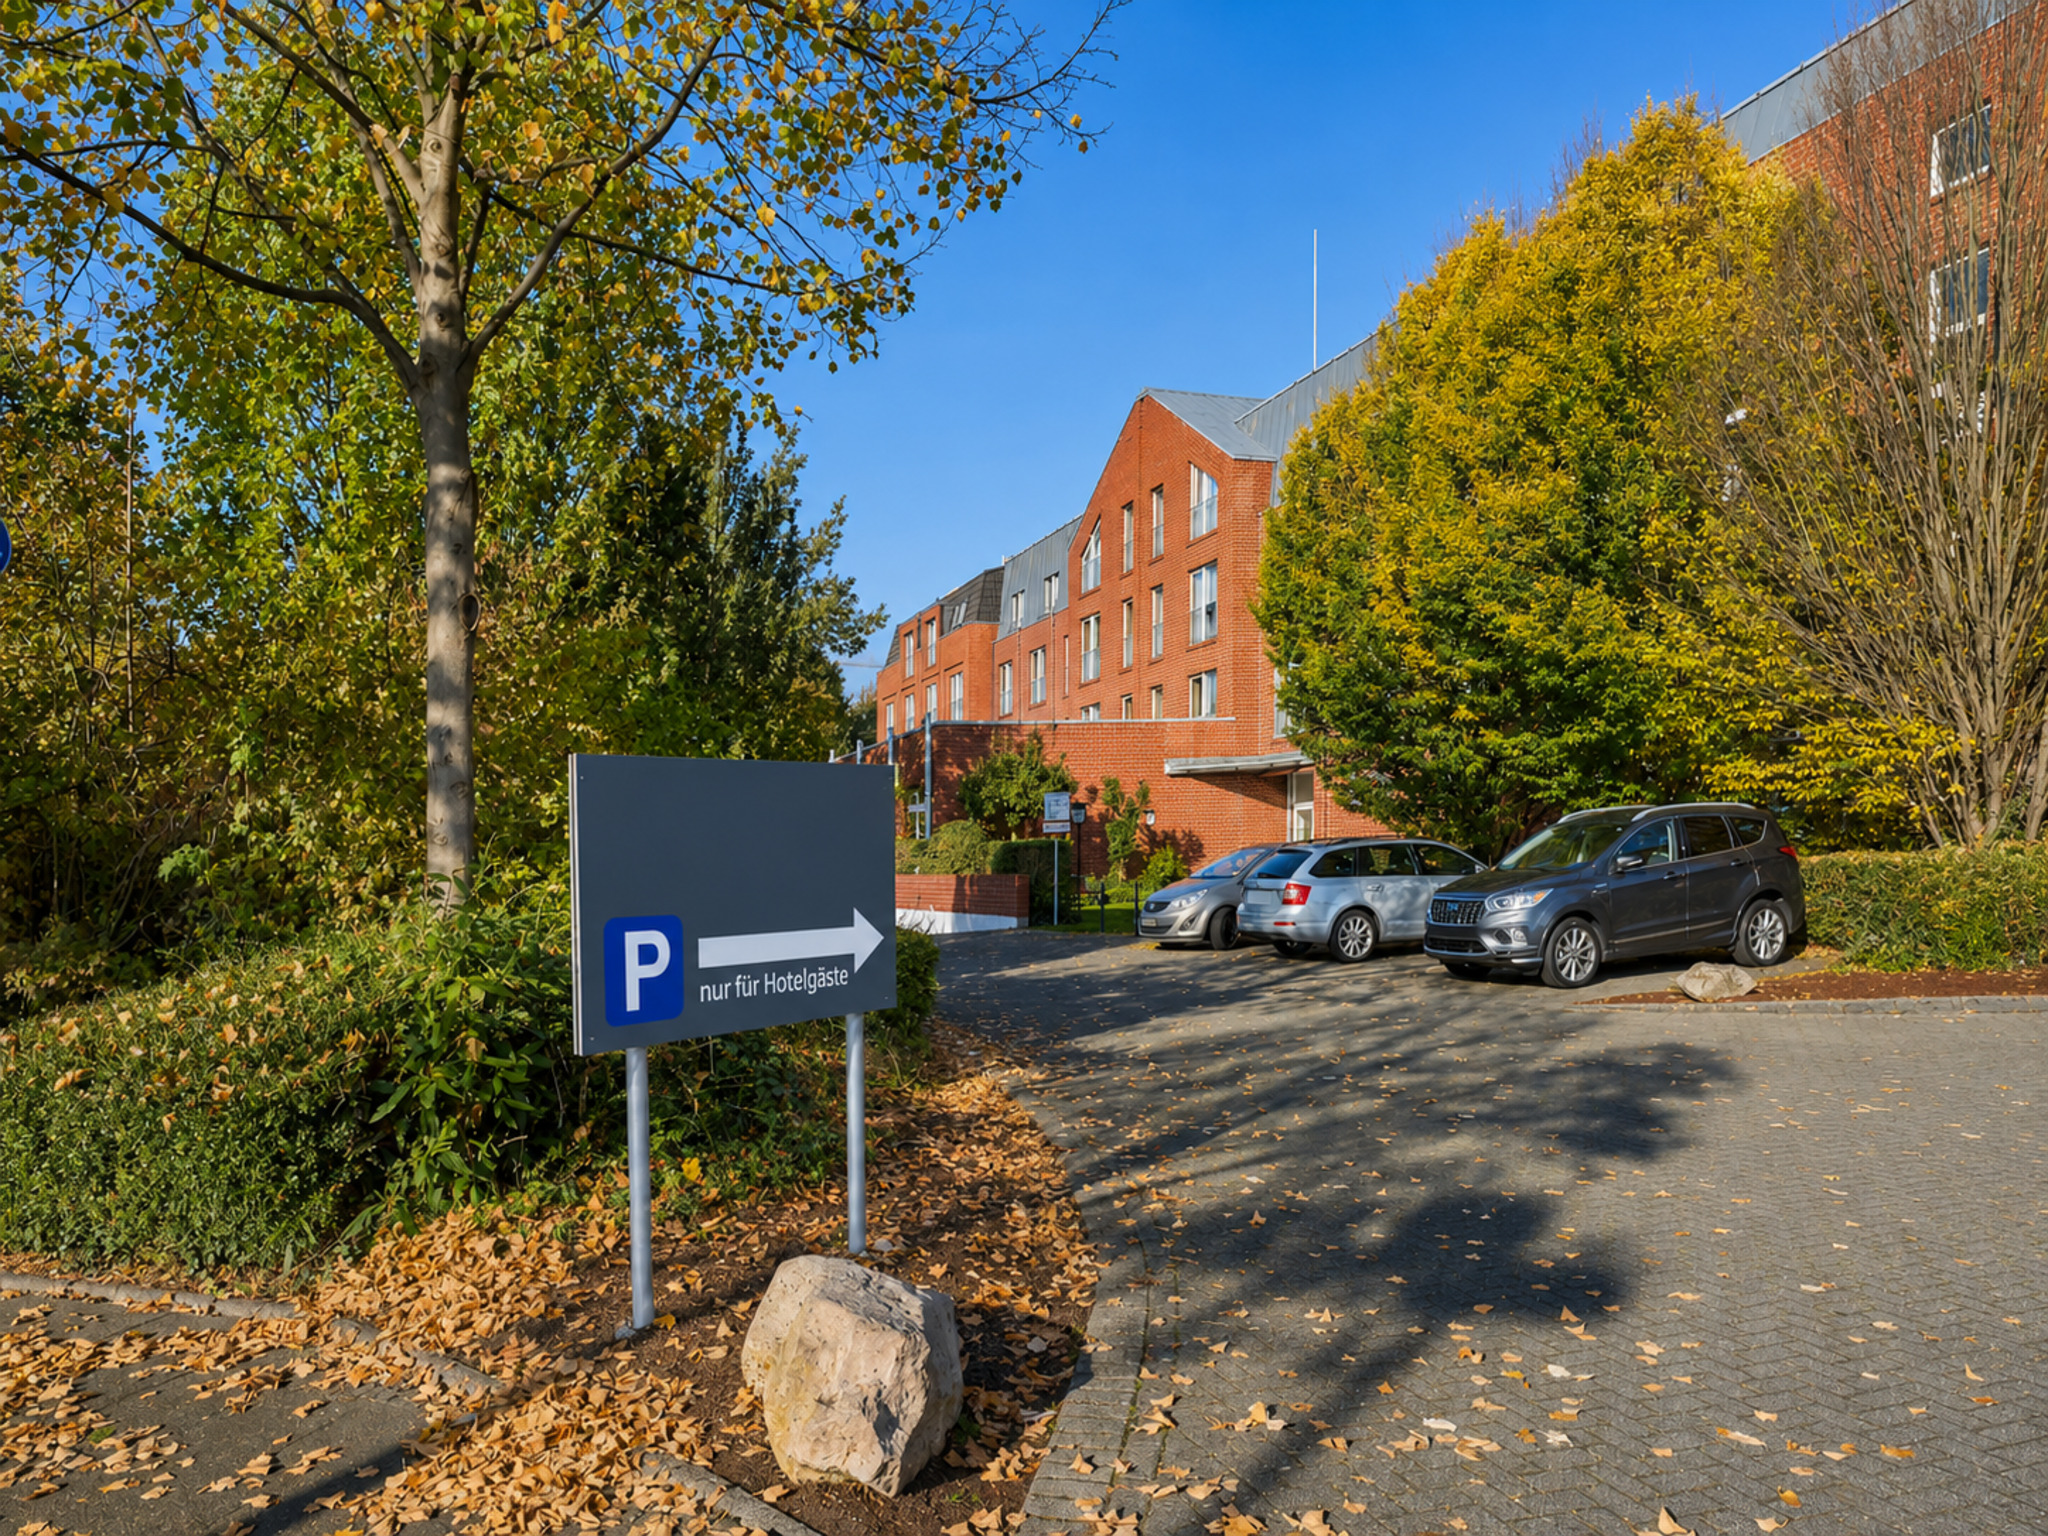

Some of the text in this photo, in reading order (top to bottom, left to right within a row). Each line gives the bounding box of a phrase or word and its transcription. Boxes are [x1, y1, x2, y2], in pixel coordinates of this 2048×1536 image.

[624, 930, 671, 1012] P
[700, 966, 849, 1002] nur für Hotelgäste
